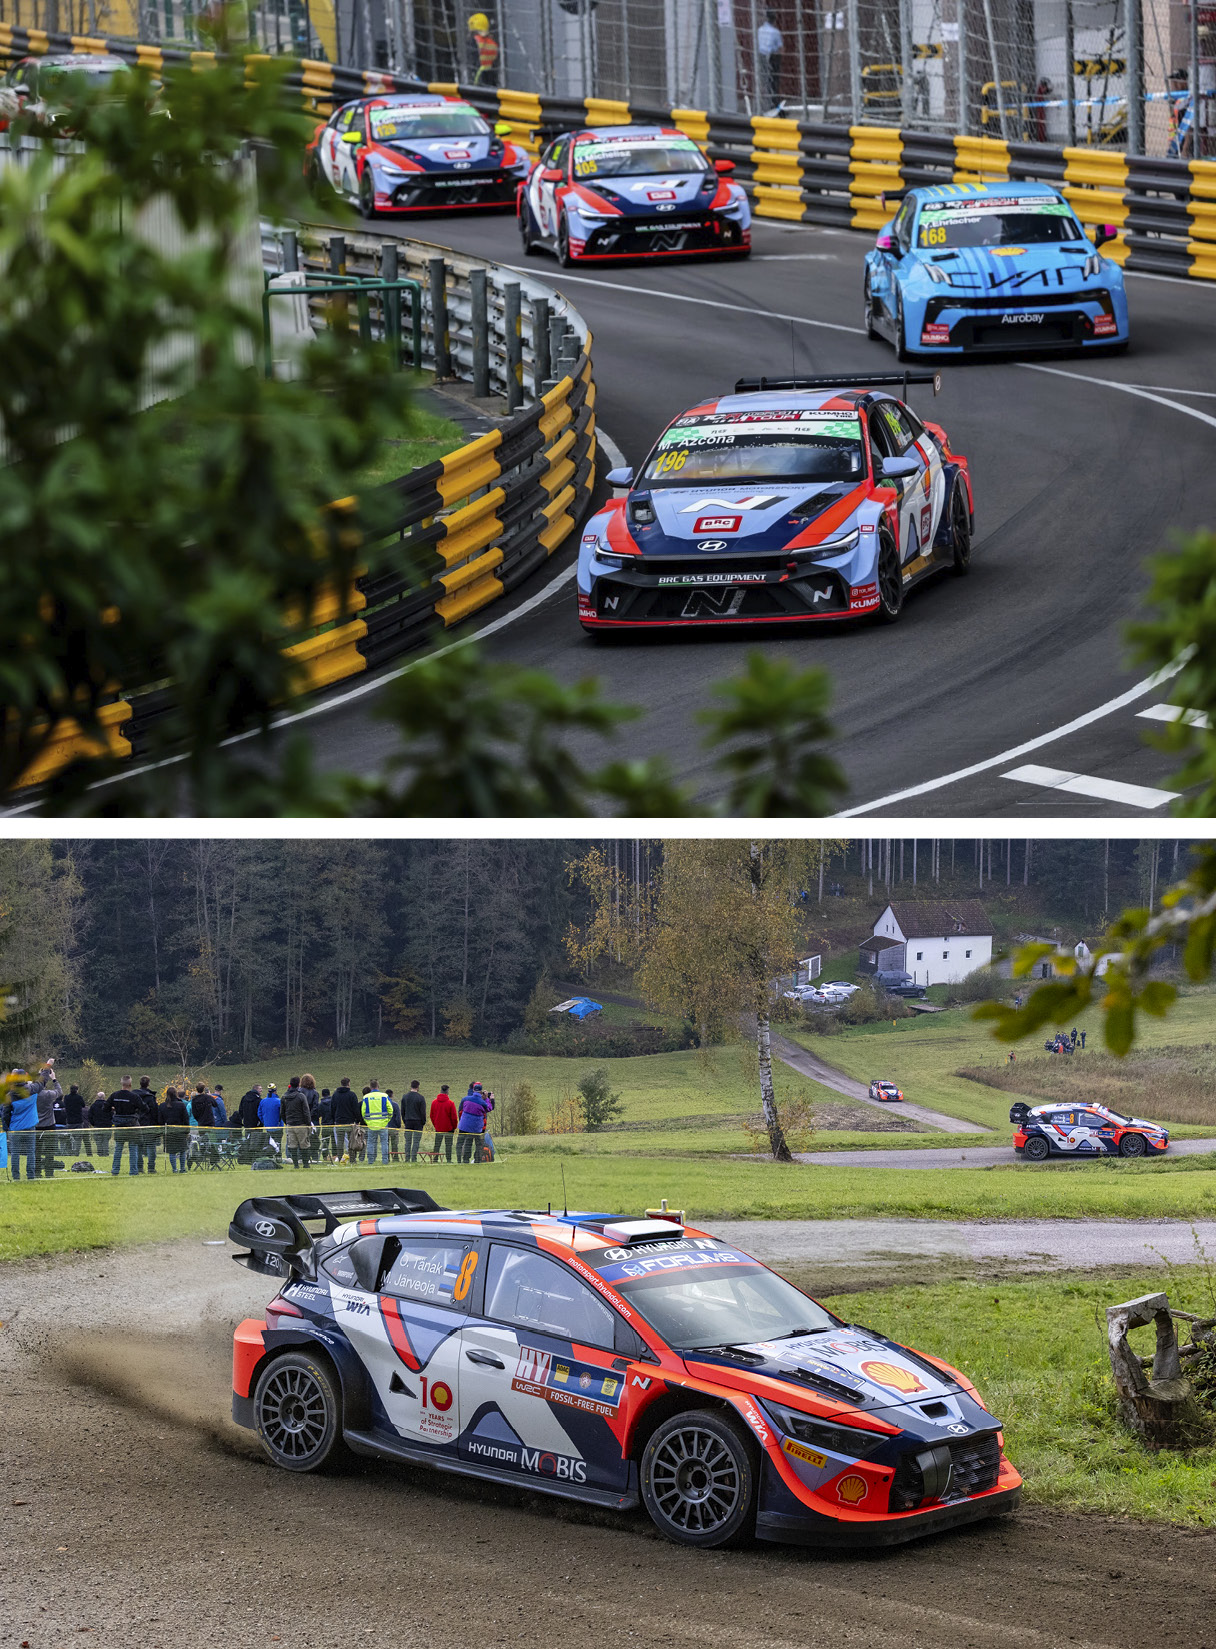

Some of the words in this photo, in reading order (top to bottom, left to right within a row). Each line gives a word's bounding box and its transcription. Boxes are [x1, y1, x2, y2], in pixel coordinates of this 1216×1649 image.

[574, 160, 598, 176] 105
[920, 227, 947, 247] 168
[1001, 313, 1044, 324] Aurobay
[657, 441, 674, 452] M.
[678, 435, 735, 447] Azcona
[655, 449, 690, 474] 196
[706, 574, 766, 582] EQUIPMENT
[1069, 1113, 1075, 1124] 8
[632, 1240, 692, 1255] HYUNDAI
[399, 1254, 410, 1268] O.
[413, 1257, 443, 1276] Tänak
[638, 1251, 740, 1272] FORUM8
[380, 1269, 392, 1284] M.
[394, 1273, 436, 1296] Järveoja
[453, 1250, 479, 1302] 8
[300, 1284, 330, 1296] HYUNDAI
[568, 1256, 633, 1319] motorsport.hyundai.com
[296, 1292, 317, 1302] STEEL
[341, 1293, 365, 1302] HYUNDAI
[346, 1299, 371, 1317] WIA
[810, 1339, 888, 1358] MOBIS
[557, 1363, 570, 1374] ADAC
[515, 1381, 542, 1396] WRC
[550, 1391, 595, 1412] FOSSIL-FREE
[595, 1403, 614, 1417] FUEL
[428, 1412, 445, 1422] YEARS
[745, 1400, 766, 1427] HYUNDAI
[419, 1425, 453, 1438] Partnership
[420, 1418, 427, 1426] of
[427, 1419, 453, 1431] Strategic
[745, 1410, 769, 1442] WIA
[786, 1441, 824, 1465] PIRELLI
[468, 1441, 518, 1463] HYUNDAI
[520, 1447, 588, 1484] MOBIS
